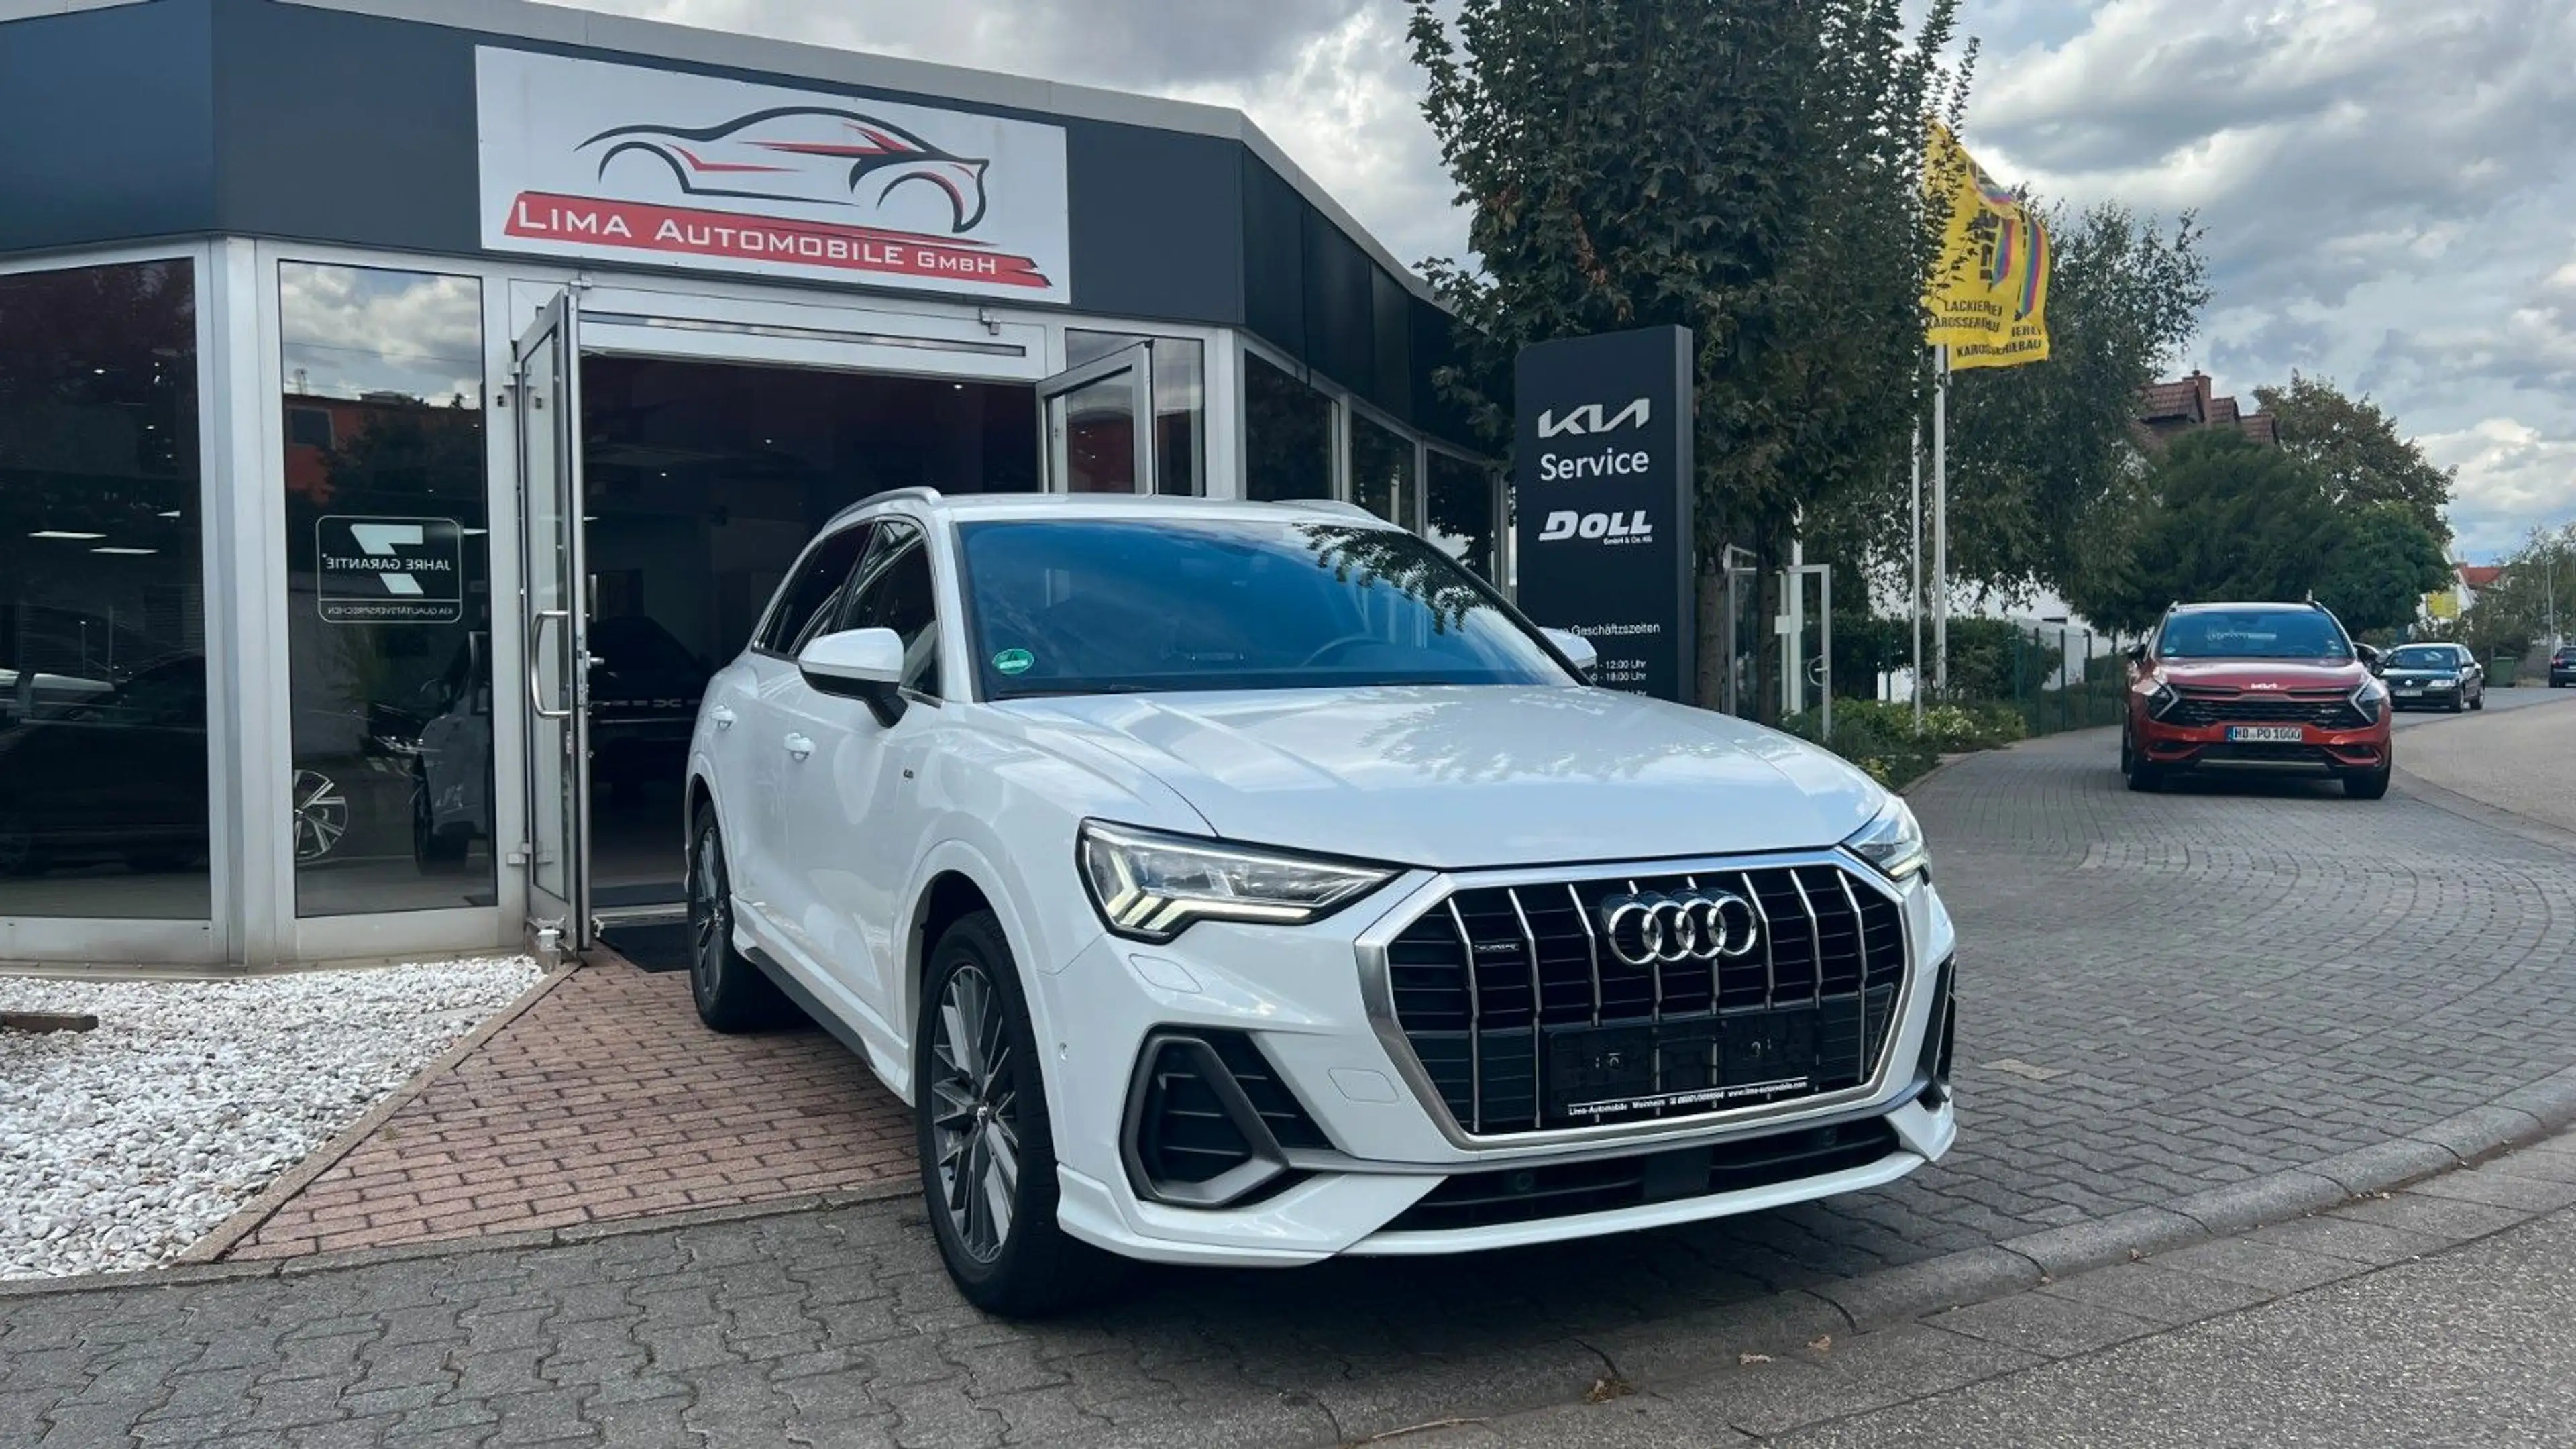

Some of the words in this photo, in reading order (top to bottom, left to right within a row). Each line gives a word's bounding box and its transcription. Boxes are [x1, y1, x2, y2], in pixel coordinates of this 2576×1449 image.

[518, 201, 632, 238] LIMA
[655, 218, 904, 265] AUTOMOBILE
[1538, 398, 1650, 438] KIA
[1540, 447, 1650, 480] Service
[1538, 511, 1653, 541] DOLL
[1631, 659, 1646, 669] Uhr
[1631, 672, 1646, 680] Uhr
